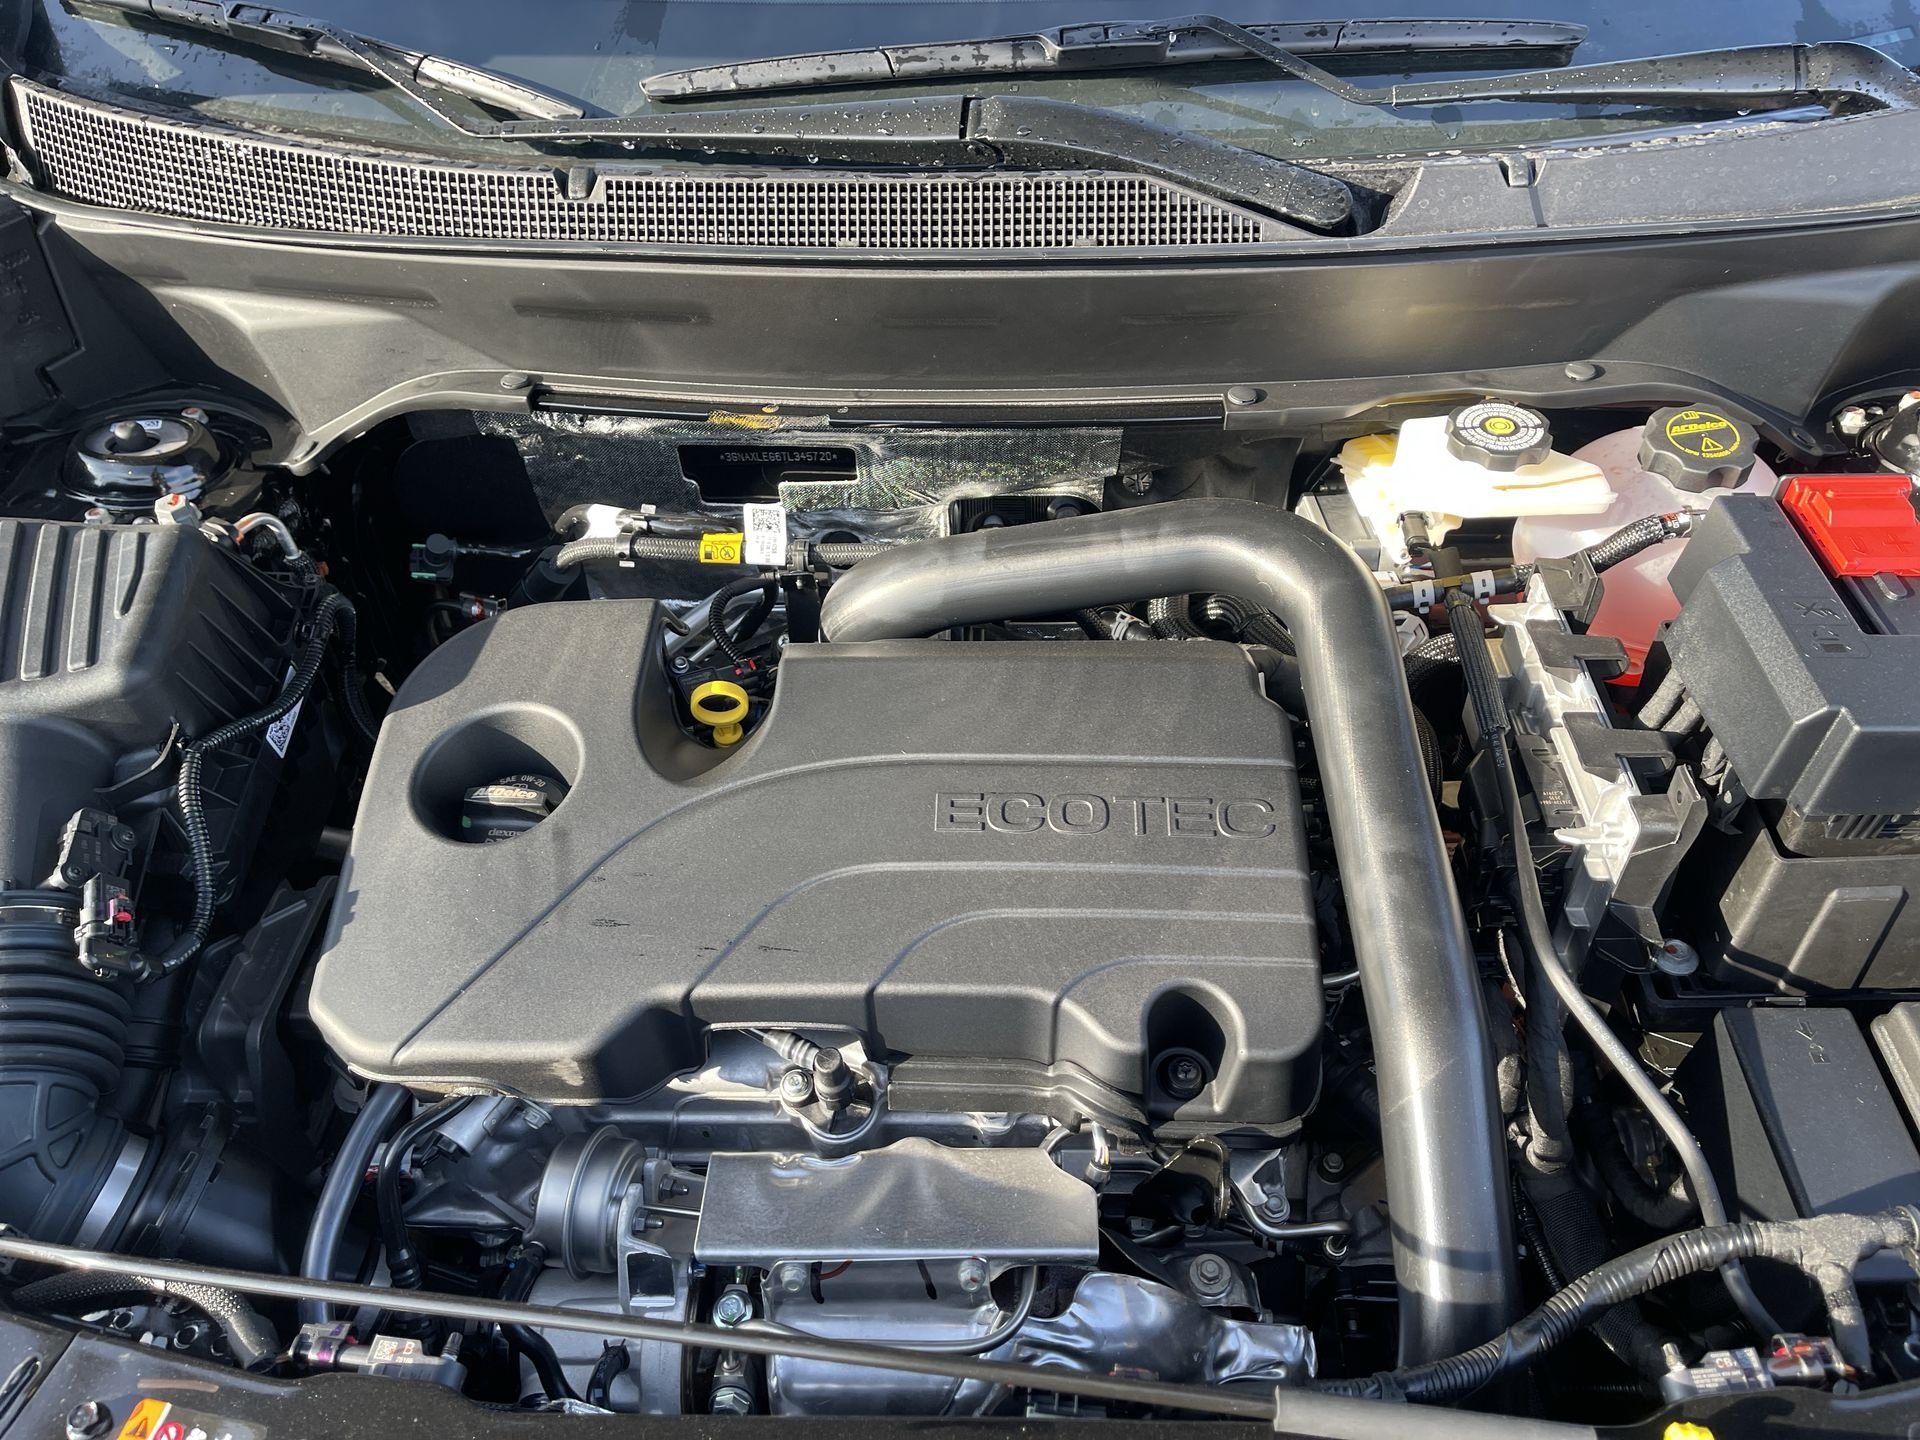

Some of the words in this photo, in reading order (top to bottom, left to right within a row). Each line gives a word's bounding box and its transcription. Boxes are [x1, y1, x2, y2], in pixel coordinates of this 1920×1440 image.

[1671, 421, 1728, 434] ACDelco
[499, 775, 517, 785] SAE
[521, 775, 546, 788] 0W-20
[472, 787, 538, 799] ACDelco
[933, 791, 1277, 840] ECOTEC
